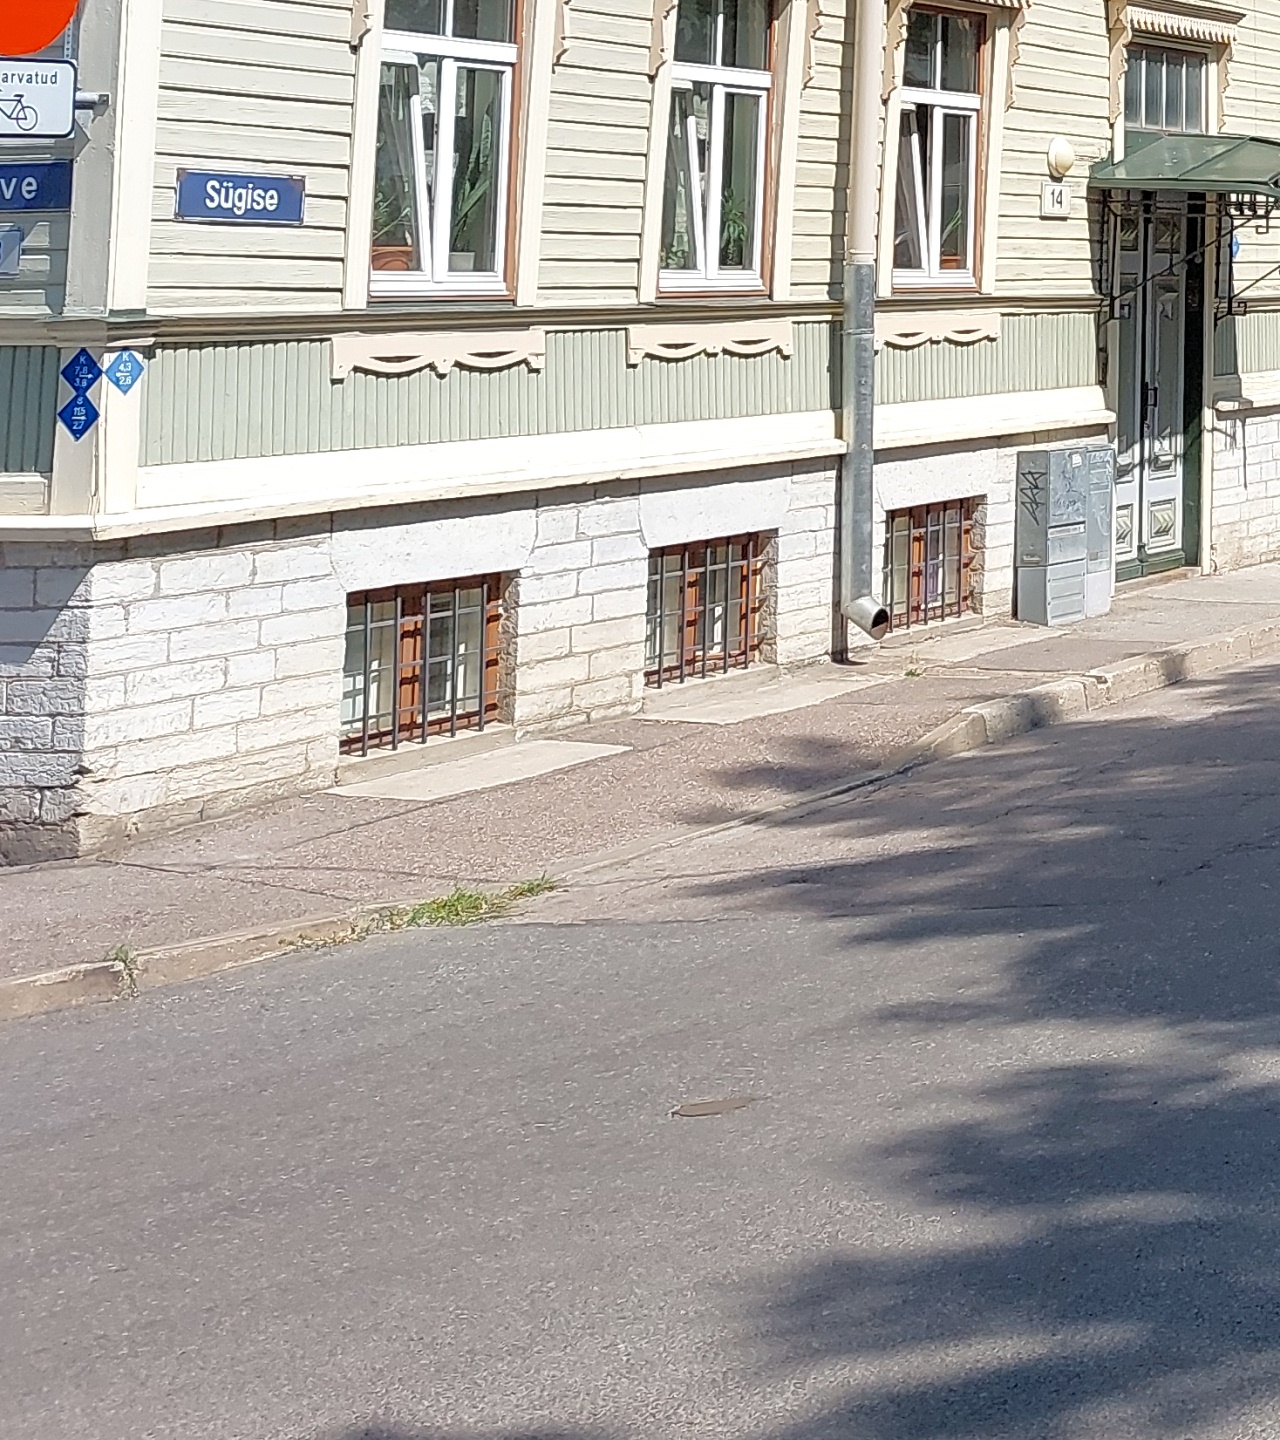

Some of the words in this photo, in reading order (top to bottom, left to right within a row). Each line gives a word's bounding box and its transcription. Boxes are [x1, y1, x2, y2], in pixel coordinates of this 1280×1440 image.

[1, 70, 58, 85] arvatud
[205, 179, 279, 216] Sügise
[1050, 188, 1063, 209] 14
[80, 356, 86, 364] K
[122, 352, 129, 361] K
